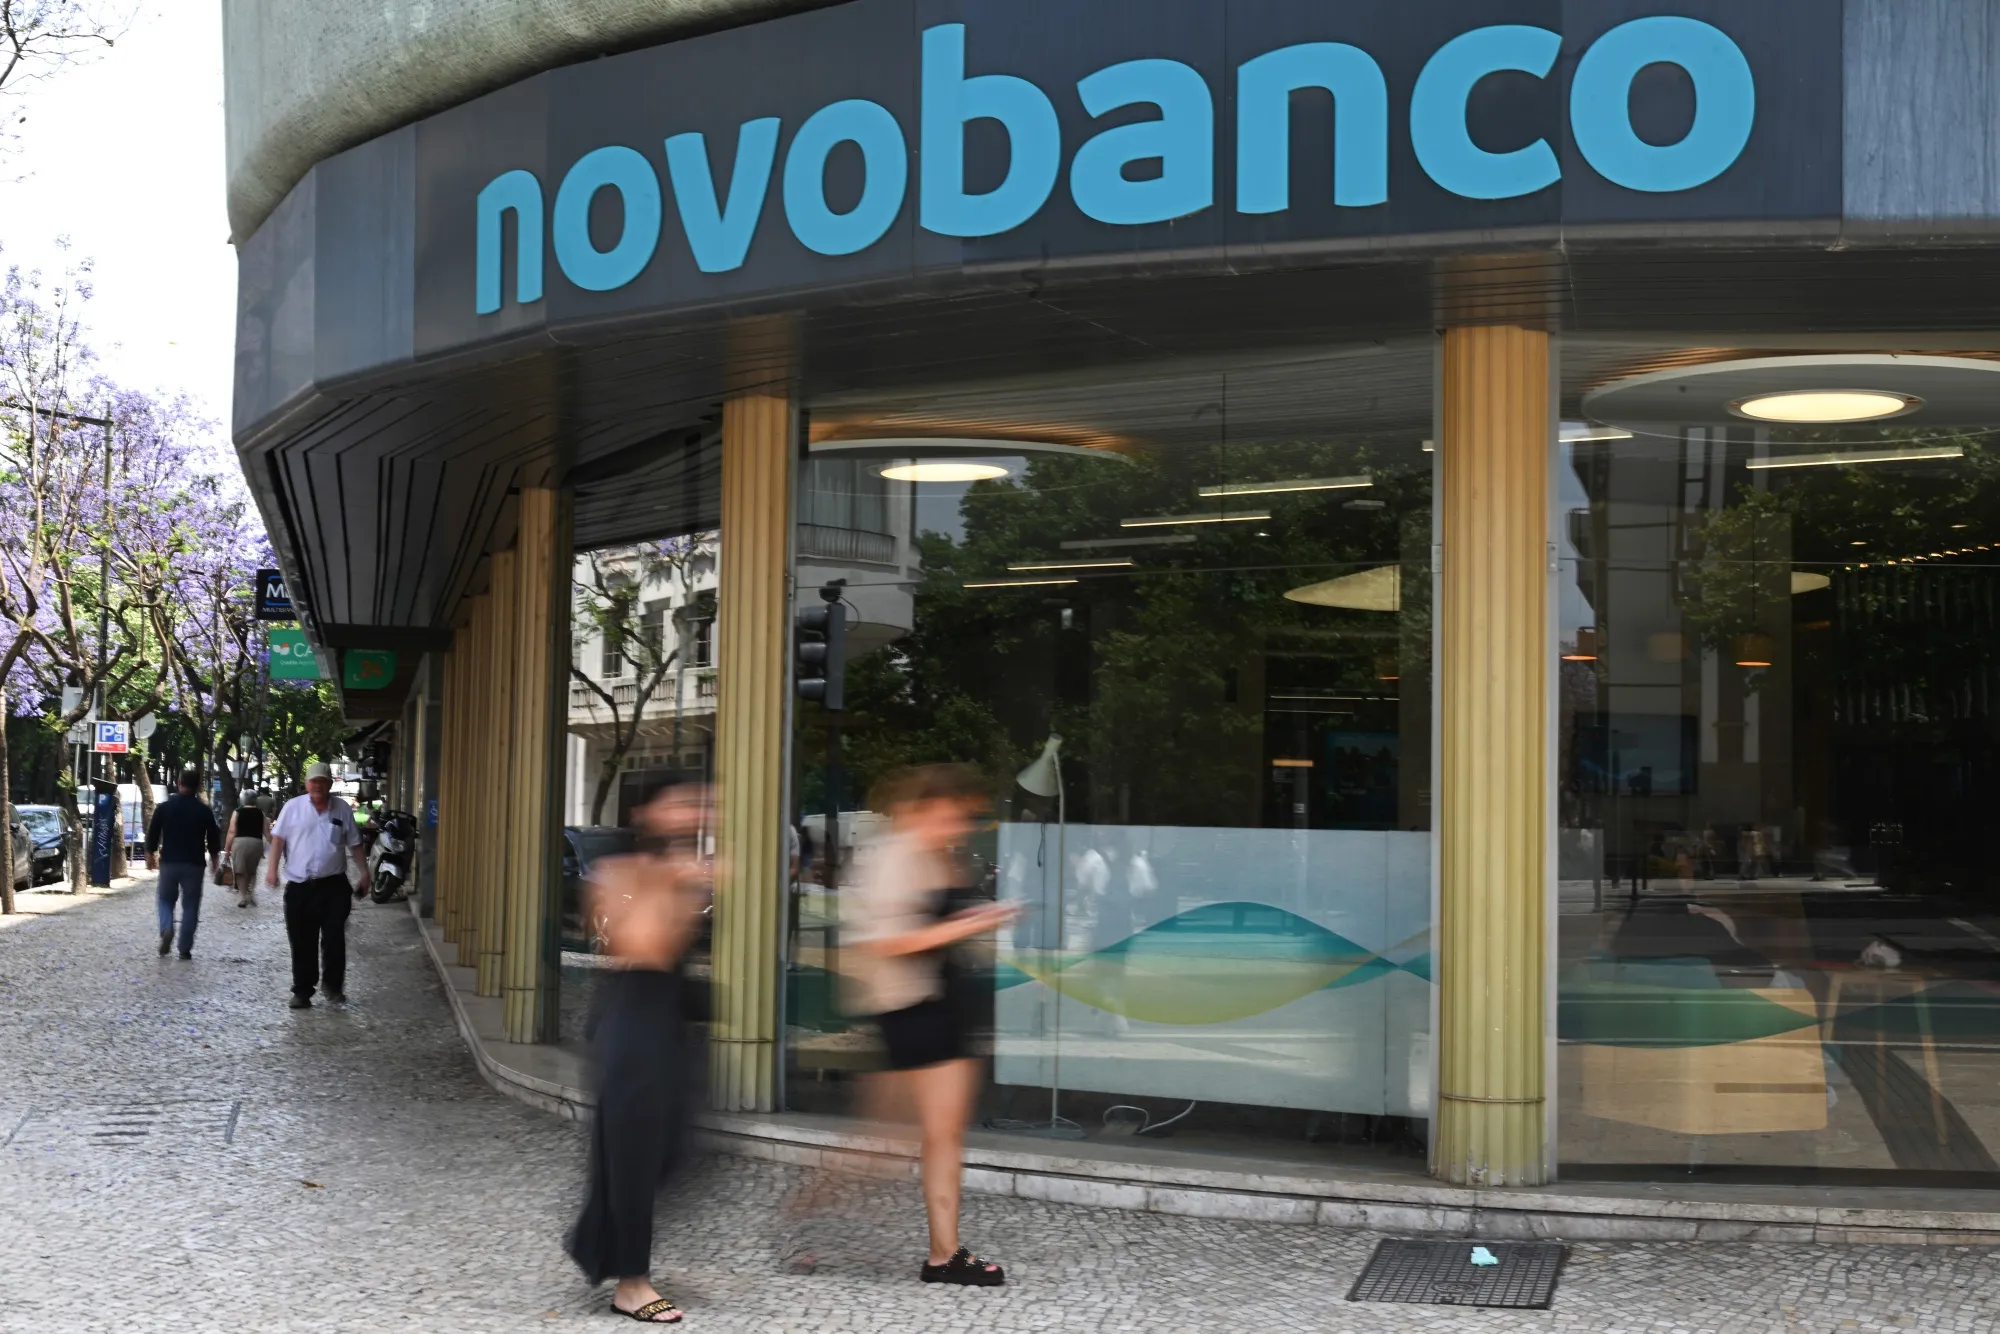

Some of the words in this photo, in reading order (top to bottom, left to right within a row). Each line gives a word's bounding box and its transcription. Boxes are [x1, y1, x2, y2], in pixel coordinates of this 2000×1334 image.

[476, 15, 1756, 315] novobanco
[266, 582, 291, 598] M
[102, 725, 115, 741] P
[99, 794, 107, 804] P
